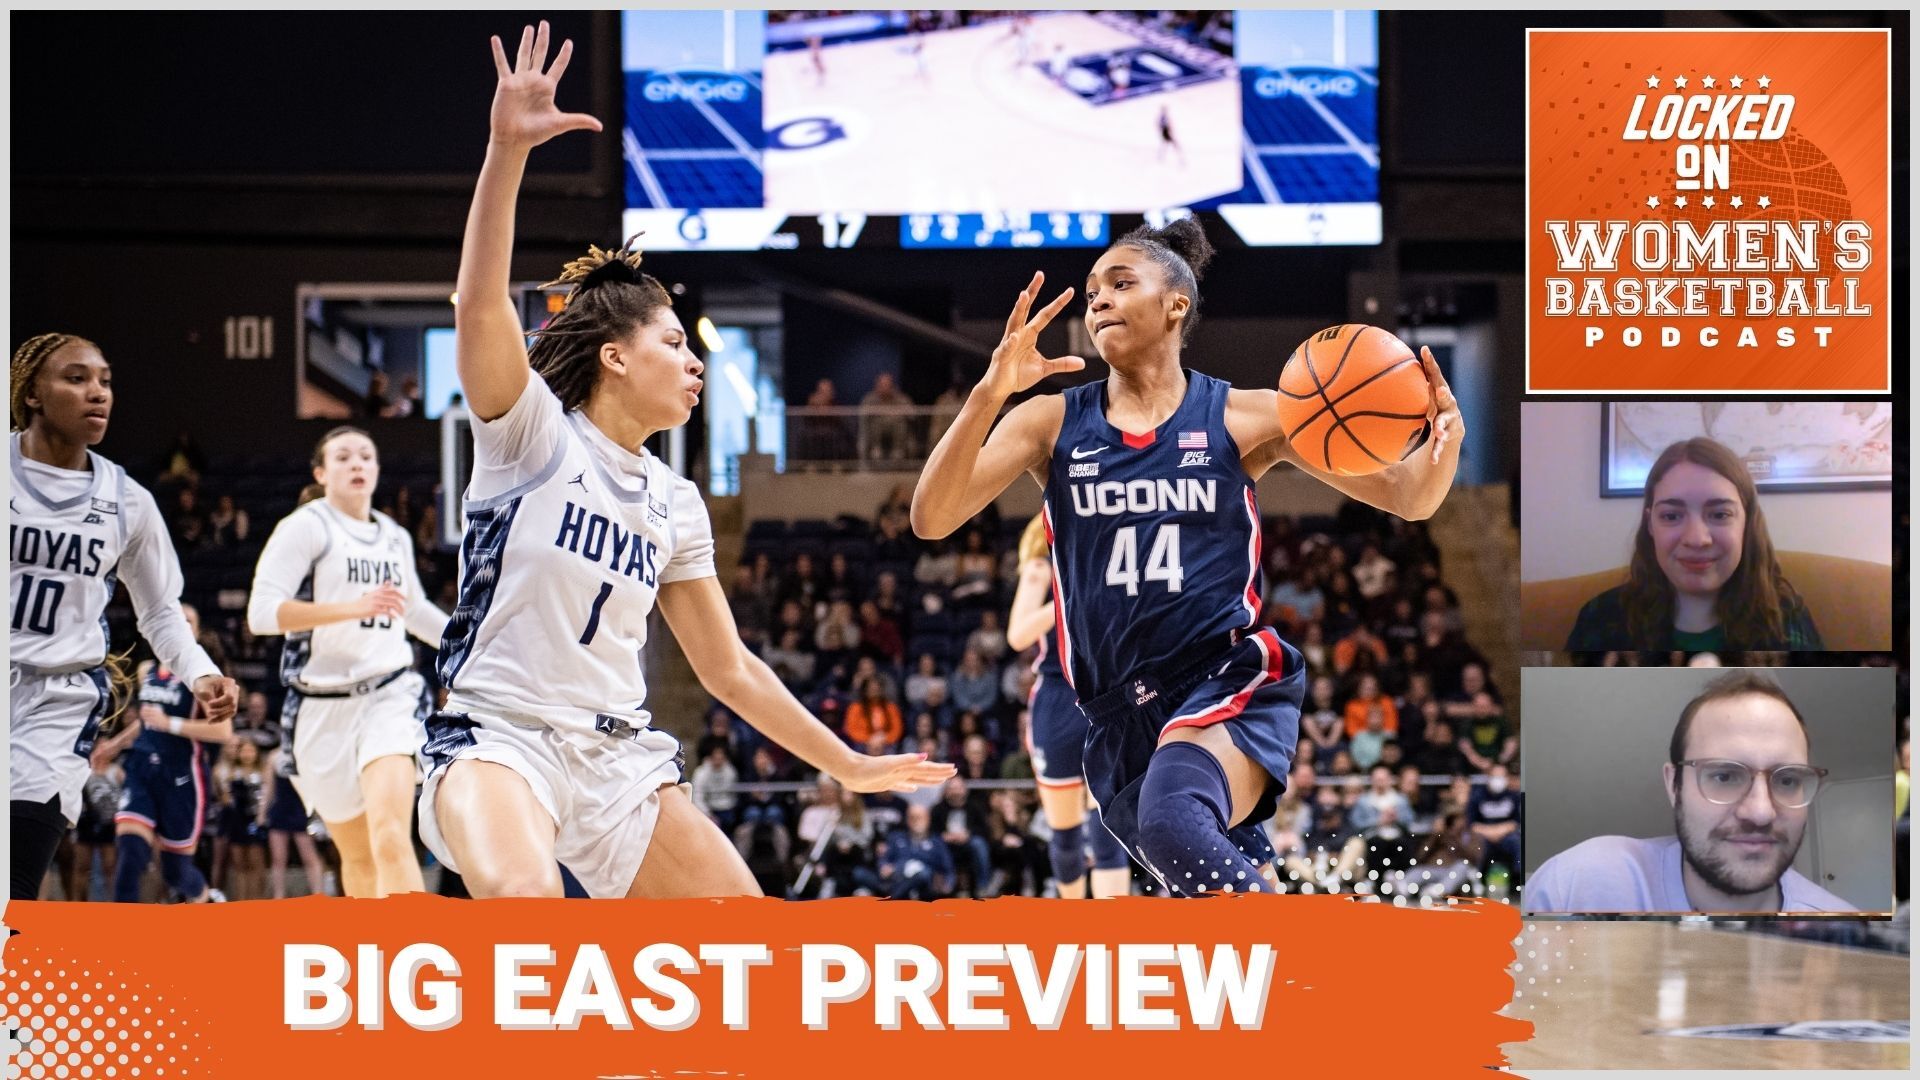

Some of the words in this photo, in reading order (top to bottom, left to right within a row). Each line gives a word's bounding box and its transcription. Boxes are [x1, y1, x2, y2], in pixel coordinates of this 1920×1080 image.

[817, 212, 867, 249] 17
[224, 315, 274, 360] 101
[1181, 456, 1212, 465] EAST
[1070, 479, 1217, 517] UCONN
[555, 501, 657, 589] HOYAS
[1105, 524, 1184, 597] 44
[347, 558, 402, 587] HOYAS
[11, 574, 65, 635] 10
[579, 581, 614, 646] 1
[1135, 689, 1158, 706] UCONN
